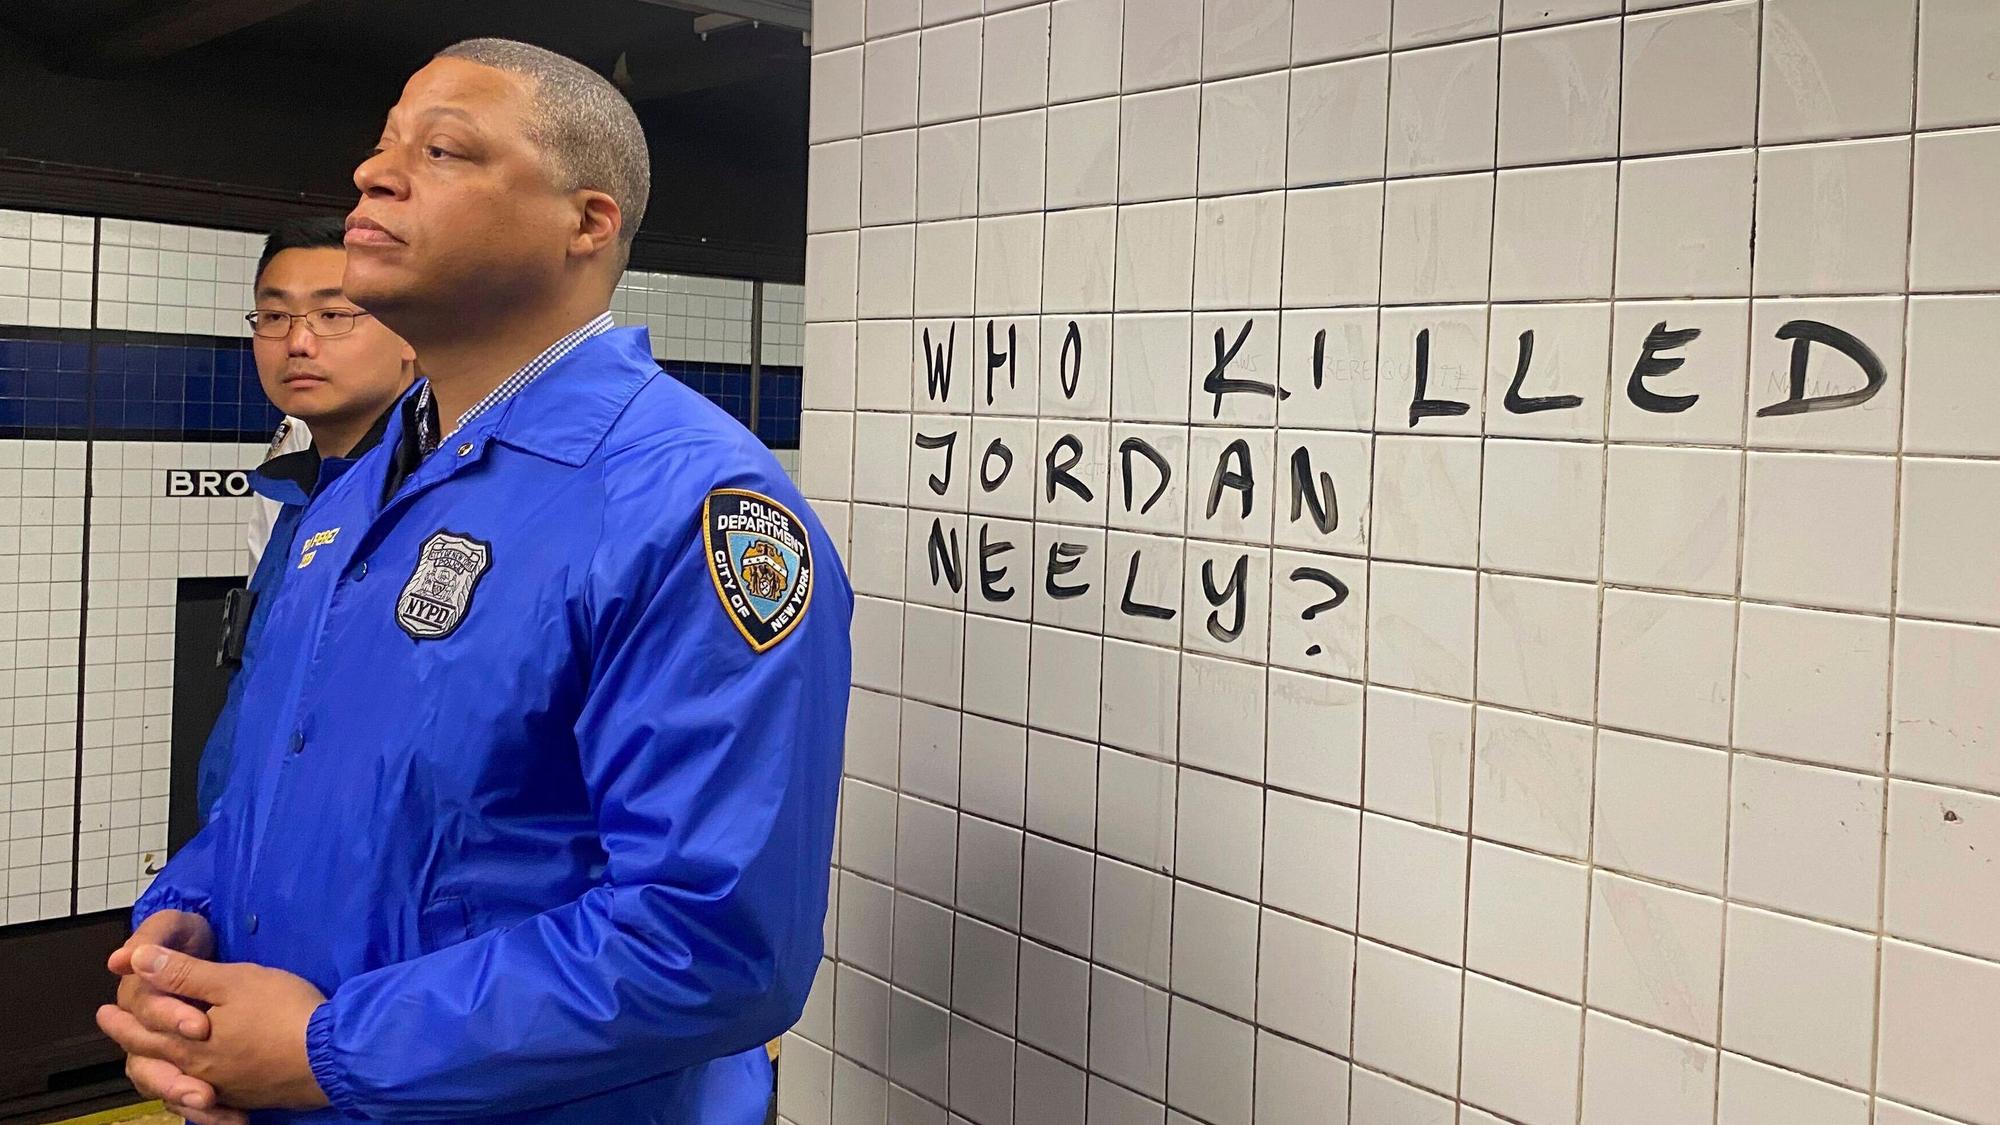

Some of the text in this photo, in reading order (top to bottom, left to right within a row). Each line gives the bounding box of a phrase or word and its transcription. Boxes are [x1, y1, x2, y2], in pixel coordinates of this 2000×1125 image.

[924, 319, 1082, 406] WHO
[1204, 318, 1886, 427] KILLED
[739, 500, 790, 531] POLICE
[916, 432, 1338, 535] JORDAN
[717, 514, 805, 557] DEPARTMENT
[405, 597, 450, 625] NYPD
[714, 550, 751, 619] CITY OF
[770, 567, 811, 633] NEW YORK
[928, 518, 1349, 656] NEELY?
